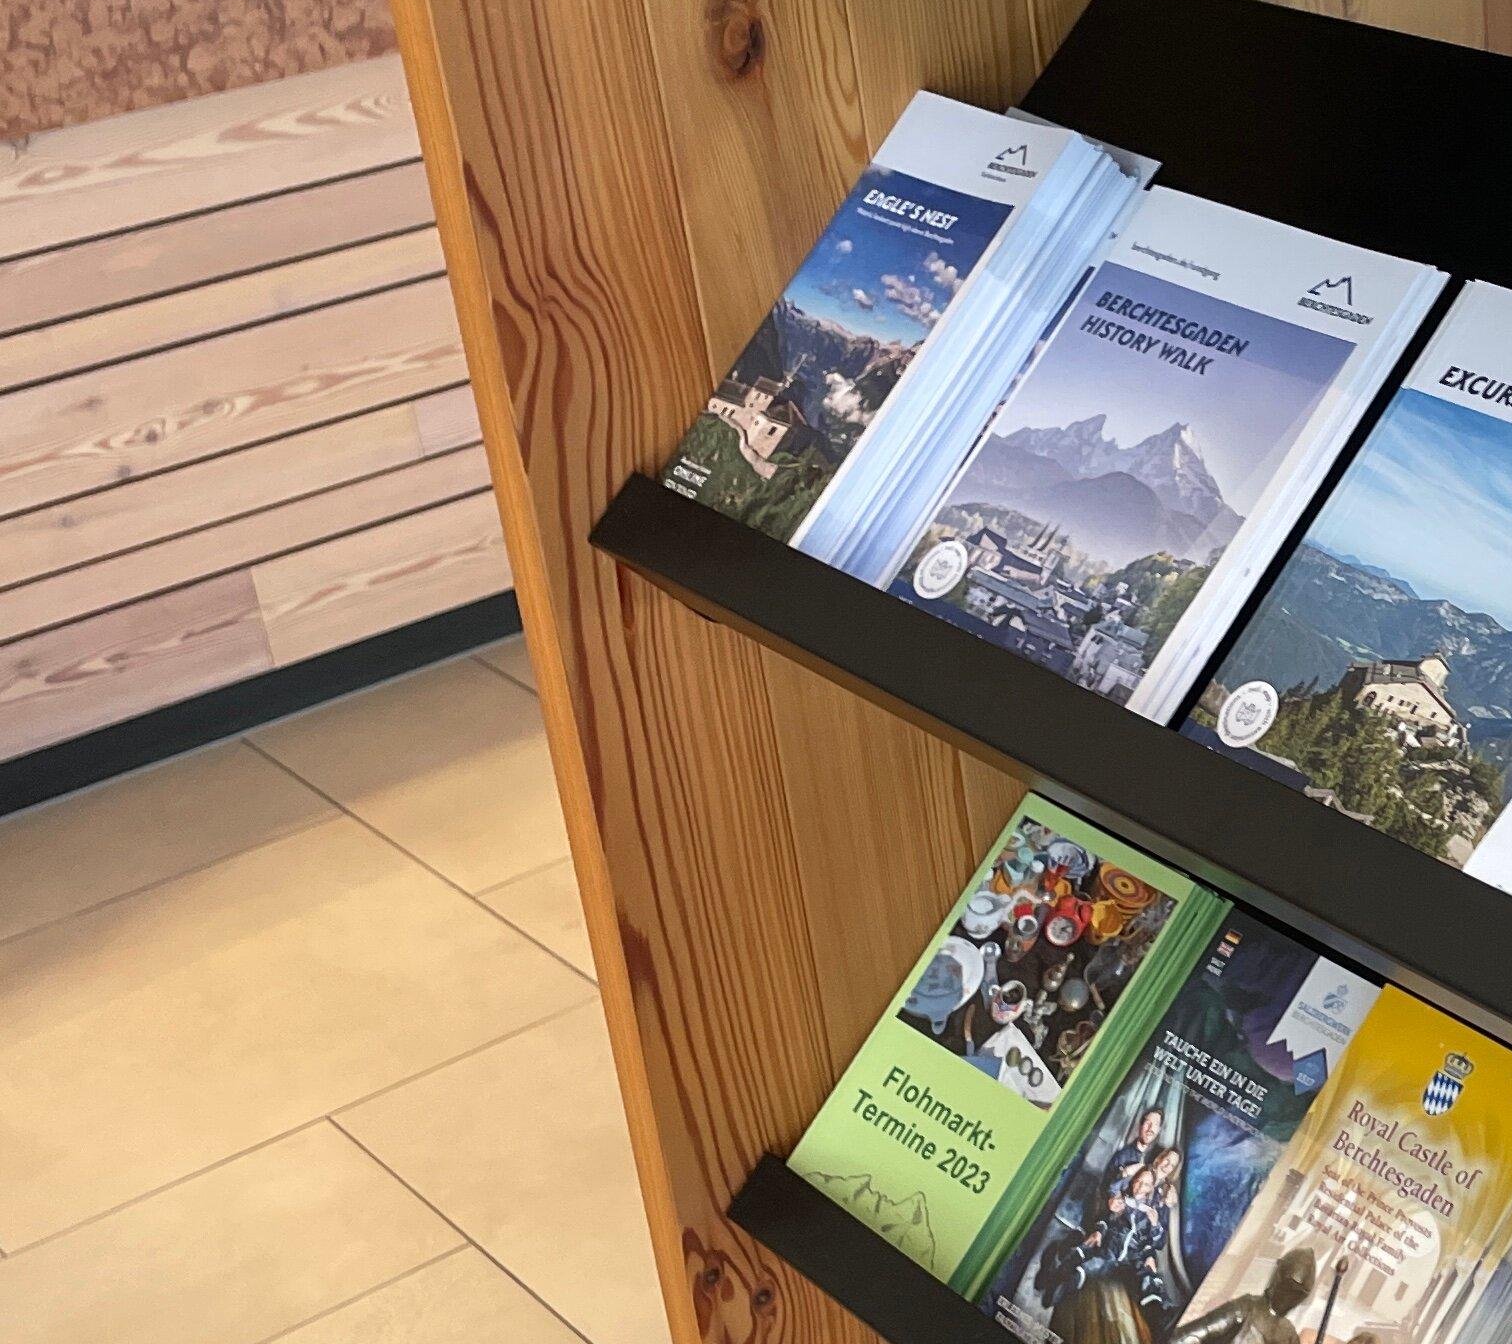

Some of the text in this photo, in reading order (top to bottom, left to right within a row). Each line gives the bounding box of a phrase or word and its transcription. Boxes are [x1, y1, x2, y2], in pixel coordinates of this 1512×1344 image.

[863, 188, 924, 220] EAGLE'S
[921, 204, 959, 230] NEST
[1080, 316, 1215, 375] HISTORY WALK
[1096, 291, 1249, 356] BERCHTESGADEN
[1151, 1045, 1187, 1074] WELT
[1184, 1065, 1229, 1100] UNTER
[1224, 1089, 1263, 1120] TAGE!
[1160, 1029, 1269, 1102] TAUCHE EIN IN DIE
[852, 1088, 991, 1194] Termine 2023
[882, 1065, 997, 1153] Flohmarkt-
[1347, 1099, 1484, 1190] Royal Castle of
[1332, 1130, 1456, 1217] Berchtesgaden
